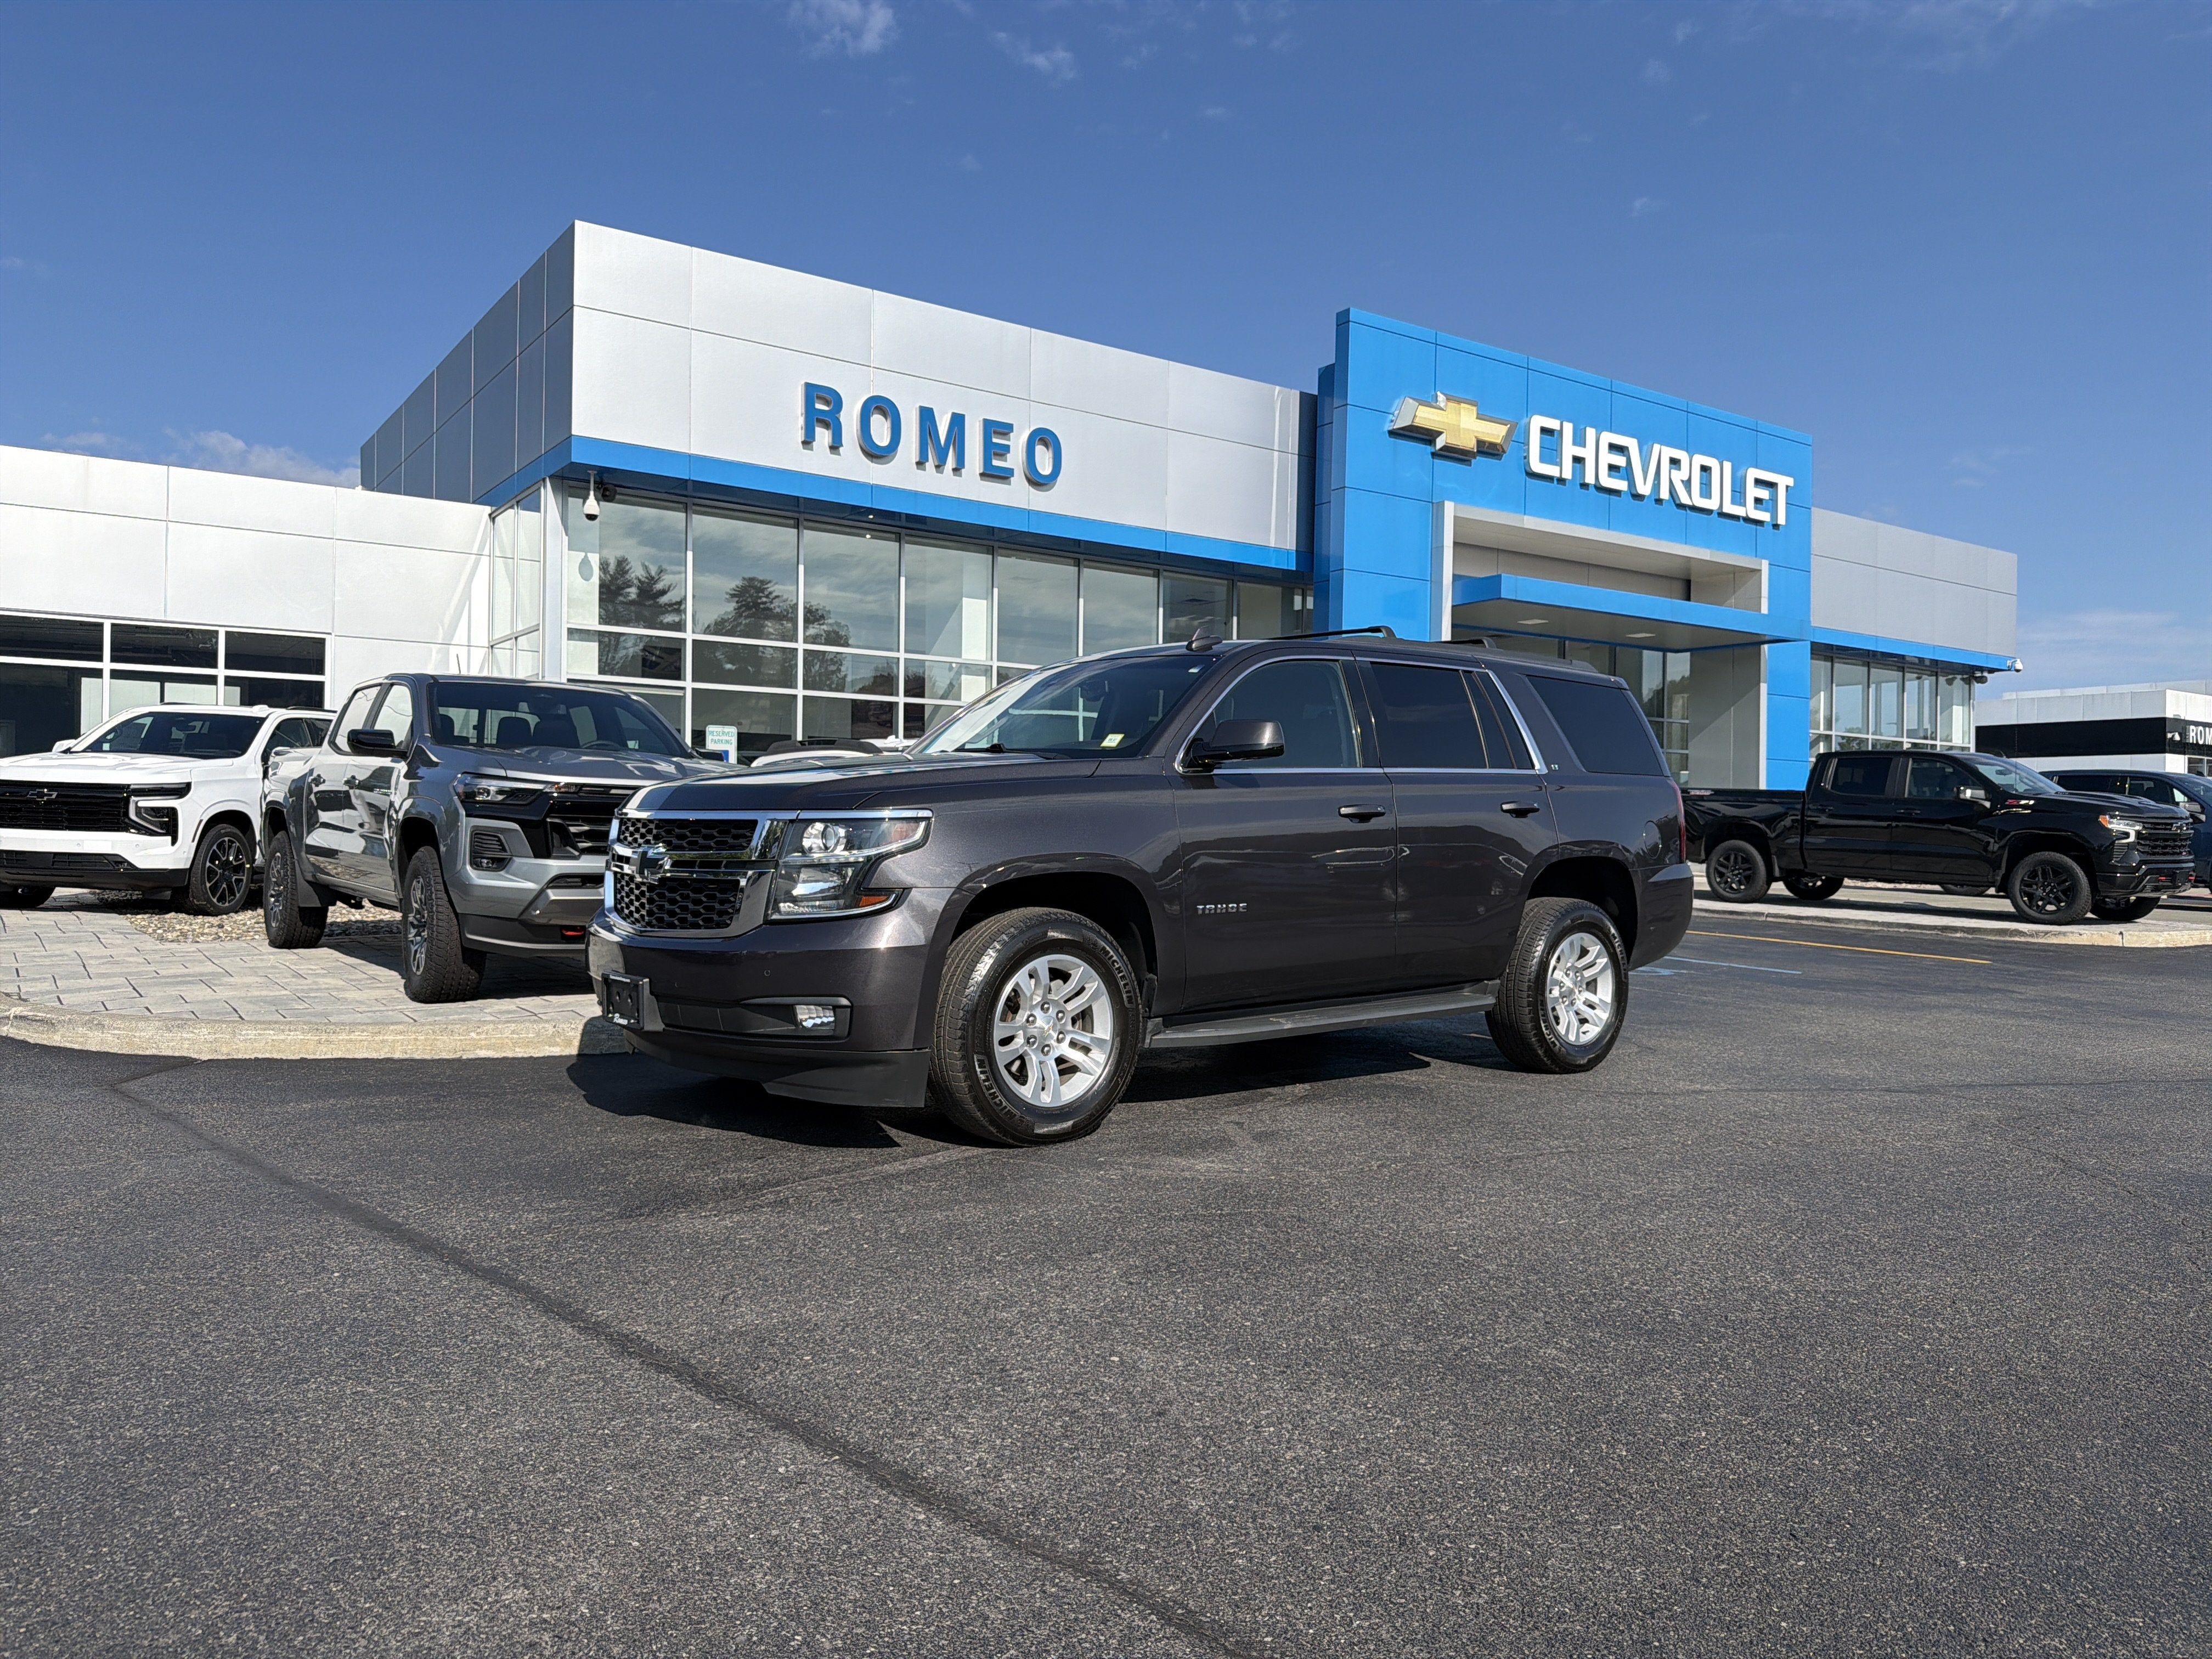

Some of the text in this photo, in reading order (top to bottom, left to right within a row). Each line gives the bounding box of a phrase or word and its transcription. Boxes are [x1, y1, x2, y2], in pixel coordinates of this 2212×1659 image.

[802, 382, 1062, 484] ROMEO
[1527, 414, 1794, 526] CHEVROLET
[1197, 903, 1247, 915] TAHOE
[1099, 946, 1134, 1005] MICHELIN
[976, 1058, 1018, 1121] MICHELIN
